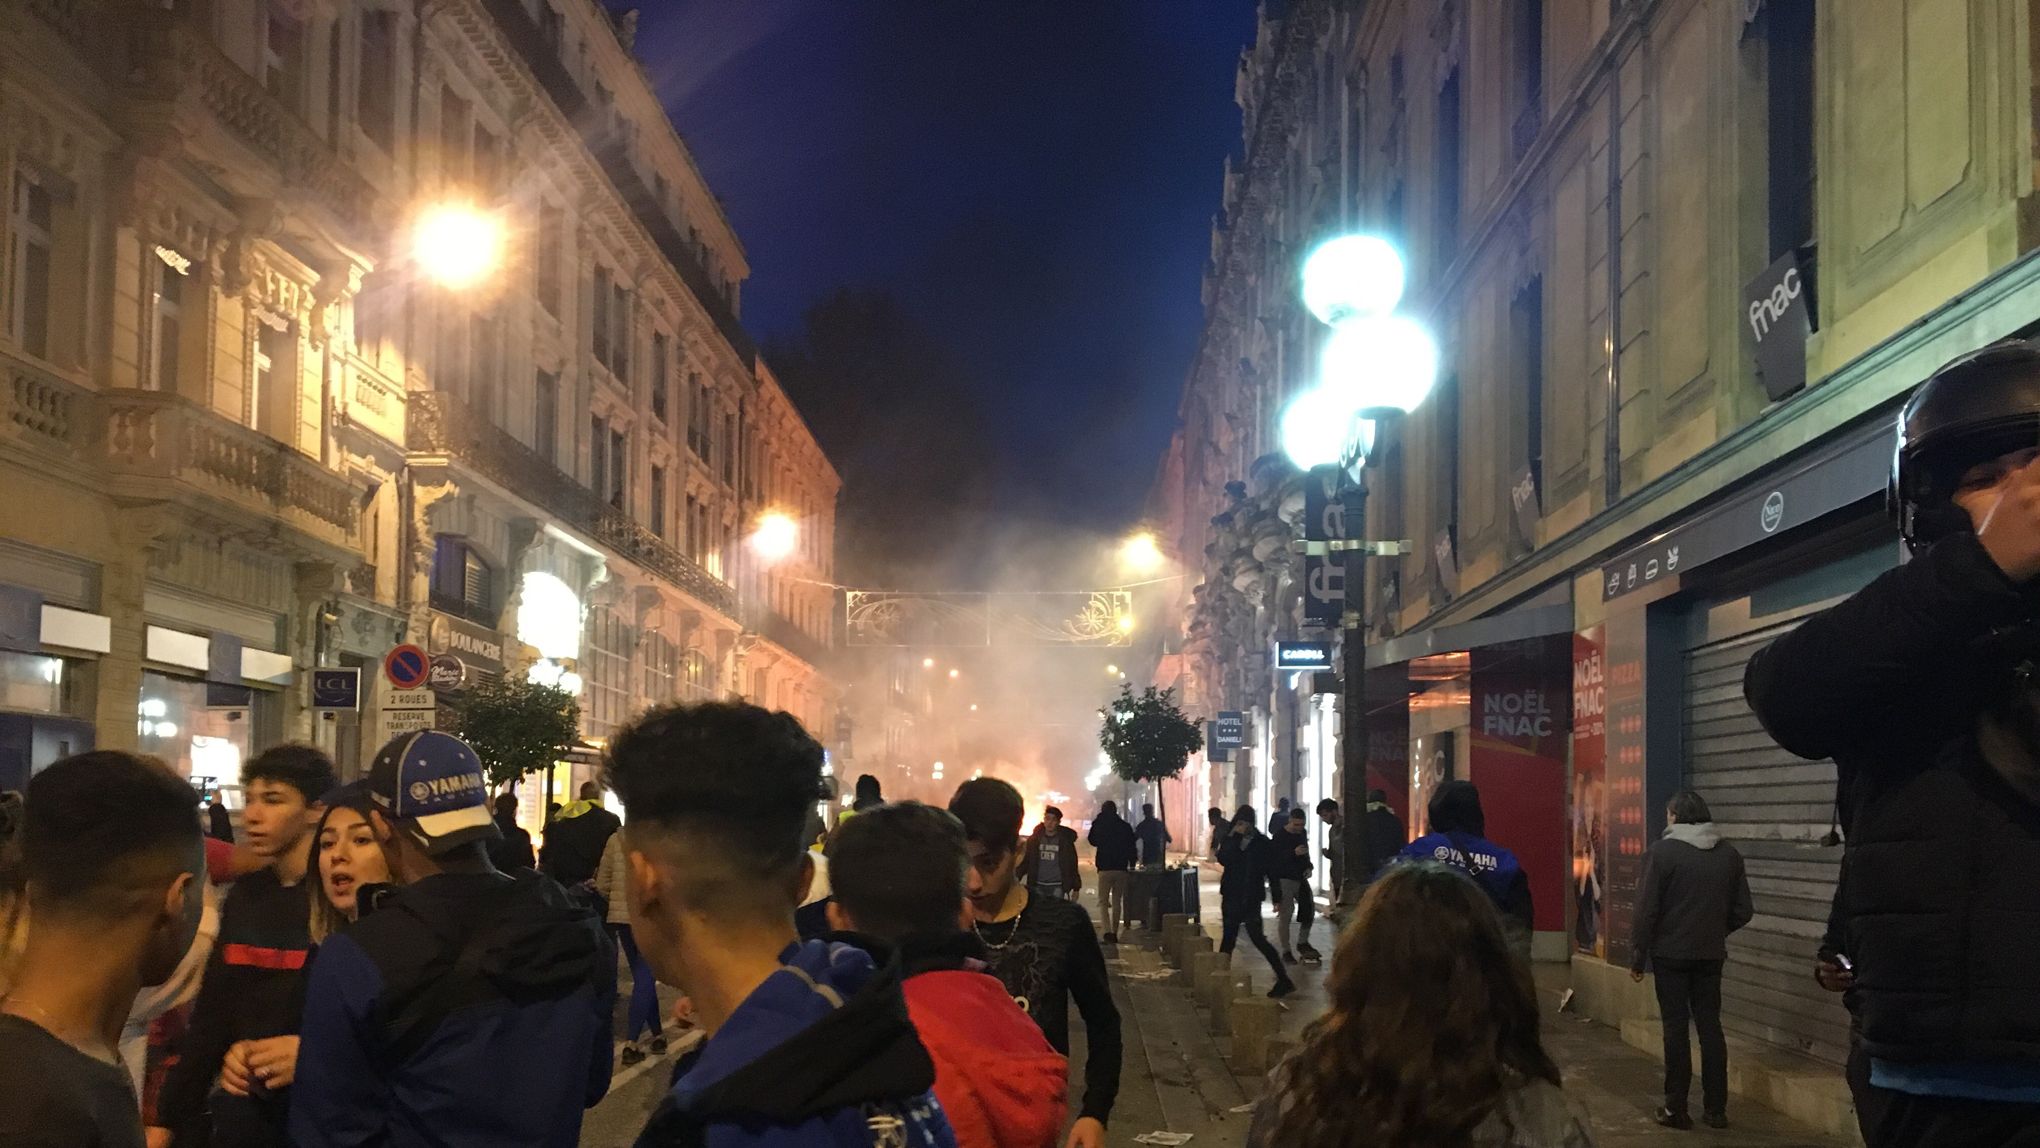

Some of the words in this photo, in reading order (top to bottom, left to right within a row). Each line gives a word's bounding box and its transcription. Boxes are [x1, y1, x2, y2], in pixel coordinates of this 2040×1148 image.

[1749, 267, 1801, 342] fnac
[1512, 472, 1534, 512] fnac
[1574, 649, 1604, 687] NOËL
[317, 678, 353, 690] LCL
[391, 695, 396, 704] 2
[399, 694, 427, 704] ROUES
[1483, 689, 1551, 714] NOËL
[1574, 686, 1604, 720] FNAC
[1217, 717, 1243, 726] HOTEL
[1483, 716, 1553, 737] FNAC
[1449, 847, 1498, 868] YAAHA
